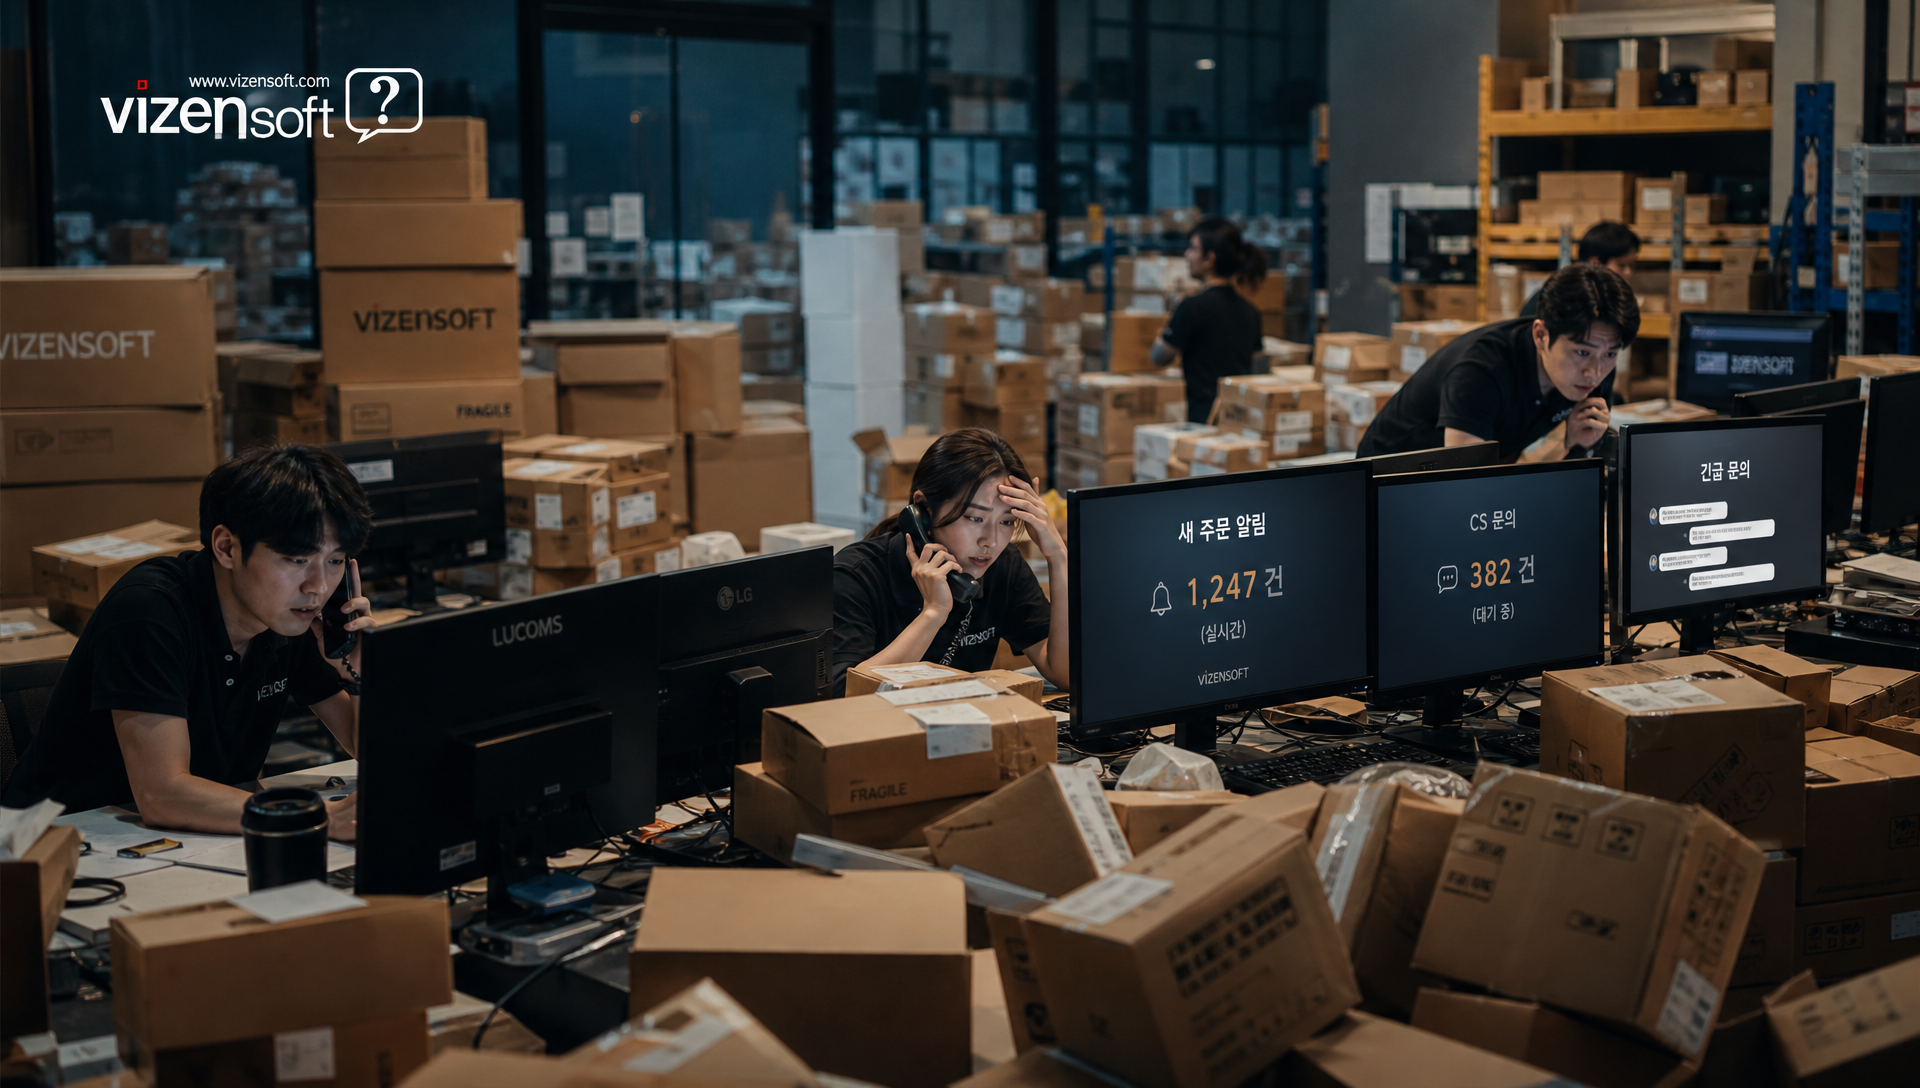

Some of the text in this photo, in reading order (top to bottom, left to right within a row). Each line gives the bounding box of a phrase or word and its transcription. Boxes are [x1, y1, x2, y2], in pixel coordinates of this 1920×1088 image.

[0, 329, 155, 360] VIZENSOFT
[457, 402, 512, 419] FRAGILE
[1700, 459, 1751, 482] 긴급 문의
[1177, 512, 1266, 544] 새 주문 알림
[1469, 508, 1517, 532] CS 문의
[1470, 554, 1535, 589] 382 건
[1187, 564, 1284, 610] 1,247 건
[1472, 602, 1516, 625] (대기 중)
[492, 614, 564, 648] LUCOMS
[1200, 619, 1247, 645] (실시간)
[849, 783, 907, 802] FRAGILE
